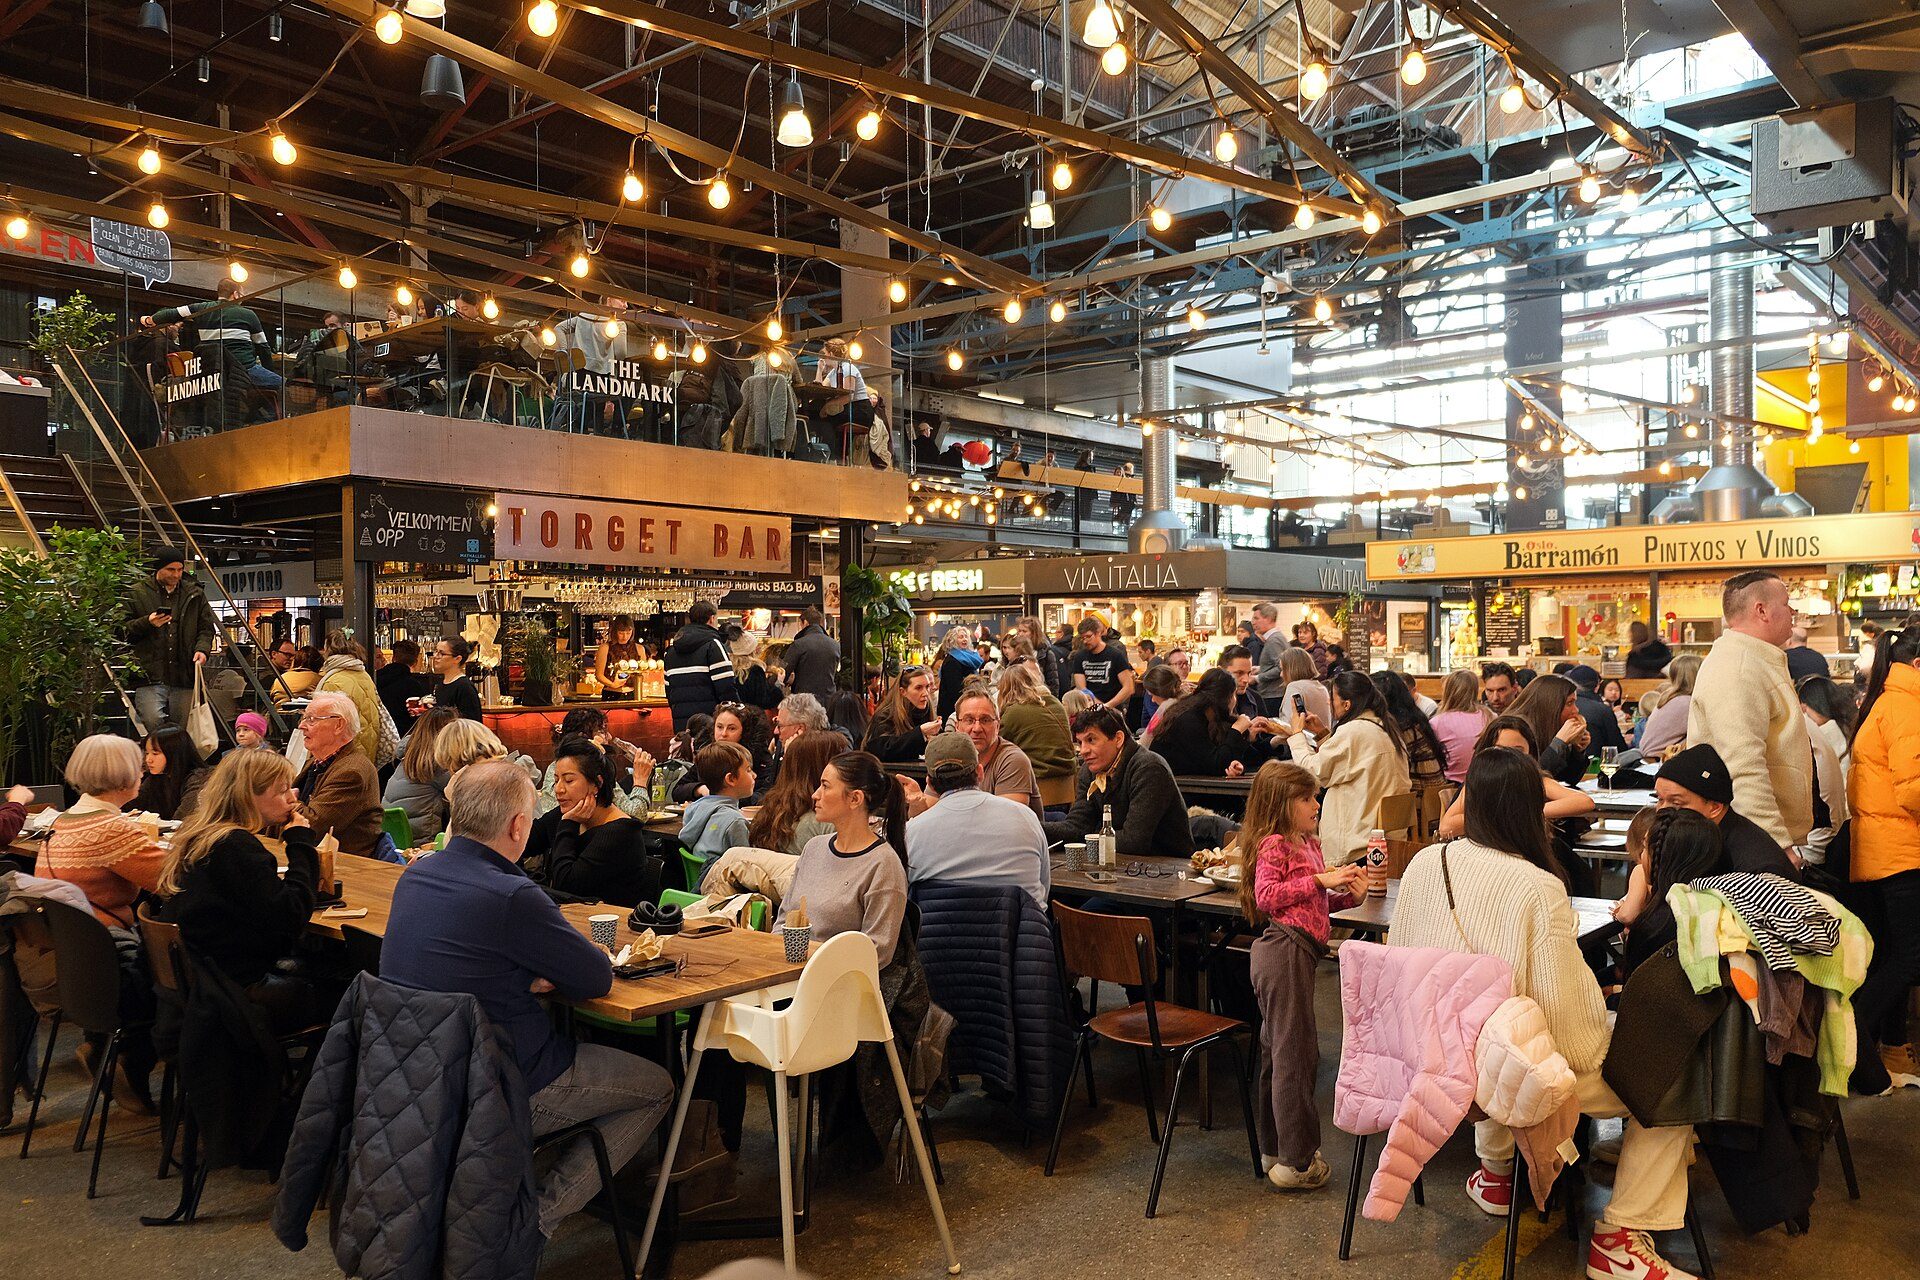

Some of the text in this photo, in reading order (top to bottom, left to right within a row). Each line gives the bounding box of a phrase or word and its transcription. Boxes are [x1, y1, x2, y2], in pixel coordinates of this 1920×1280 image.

[184, 357, 202, 377] THE
[608, 359, 641, 380] THE
[168, 373, 220, 402] LANDMARK
[572, 372, 673, 404] LANDMARK
[388, 511, 472, 532] VELKOMMEN
[508, 507, 781, 560] TORGET BAR
[376, 528, 404, 547] OPP
[1645, 530, 1820, 563] PINTXOS Y VINOS
[1503, 542, 1618, 570] Barramón
[1064, 555, 1178, 590] VIA ITALIA
[1318, 560, 1340, 590] VIA
